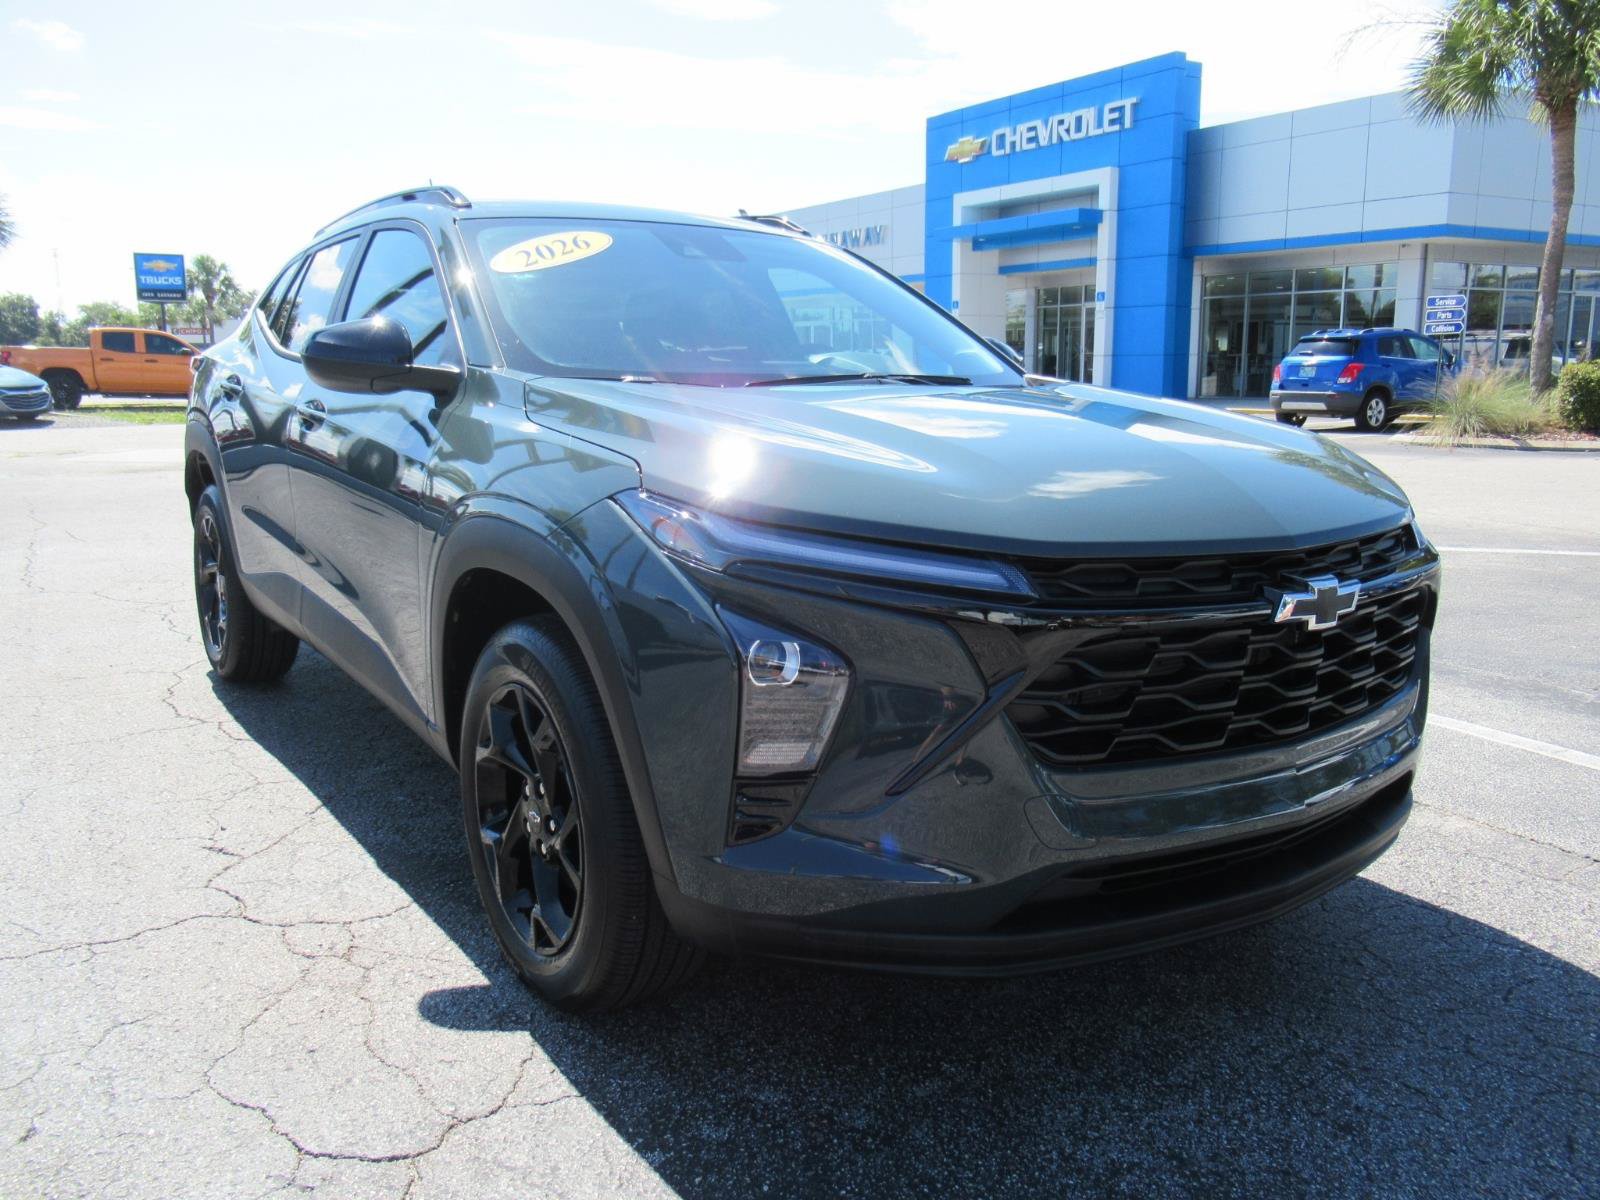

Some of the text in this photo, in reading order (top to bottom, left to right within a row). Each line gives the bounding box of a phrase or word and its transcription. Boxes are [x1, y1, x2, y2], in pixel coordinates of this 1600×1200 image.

[991, 96, 1139, 157] CHEVROLET
[515, 235, 591, 268] 2026
[140, 275, 182, 285] TRUCKS
[1435, 298, 1457, 306] Service
[1436, 311, 1452, 319] Parts
[1431, 324, 1455, 333] Collision
